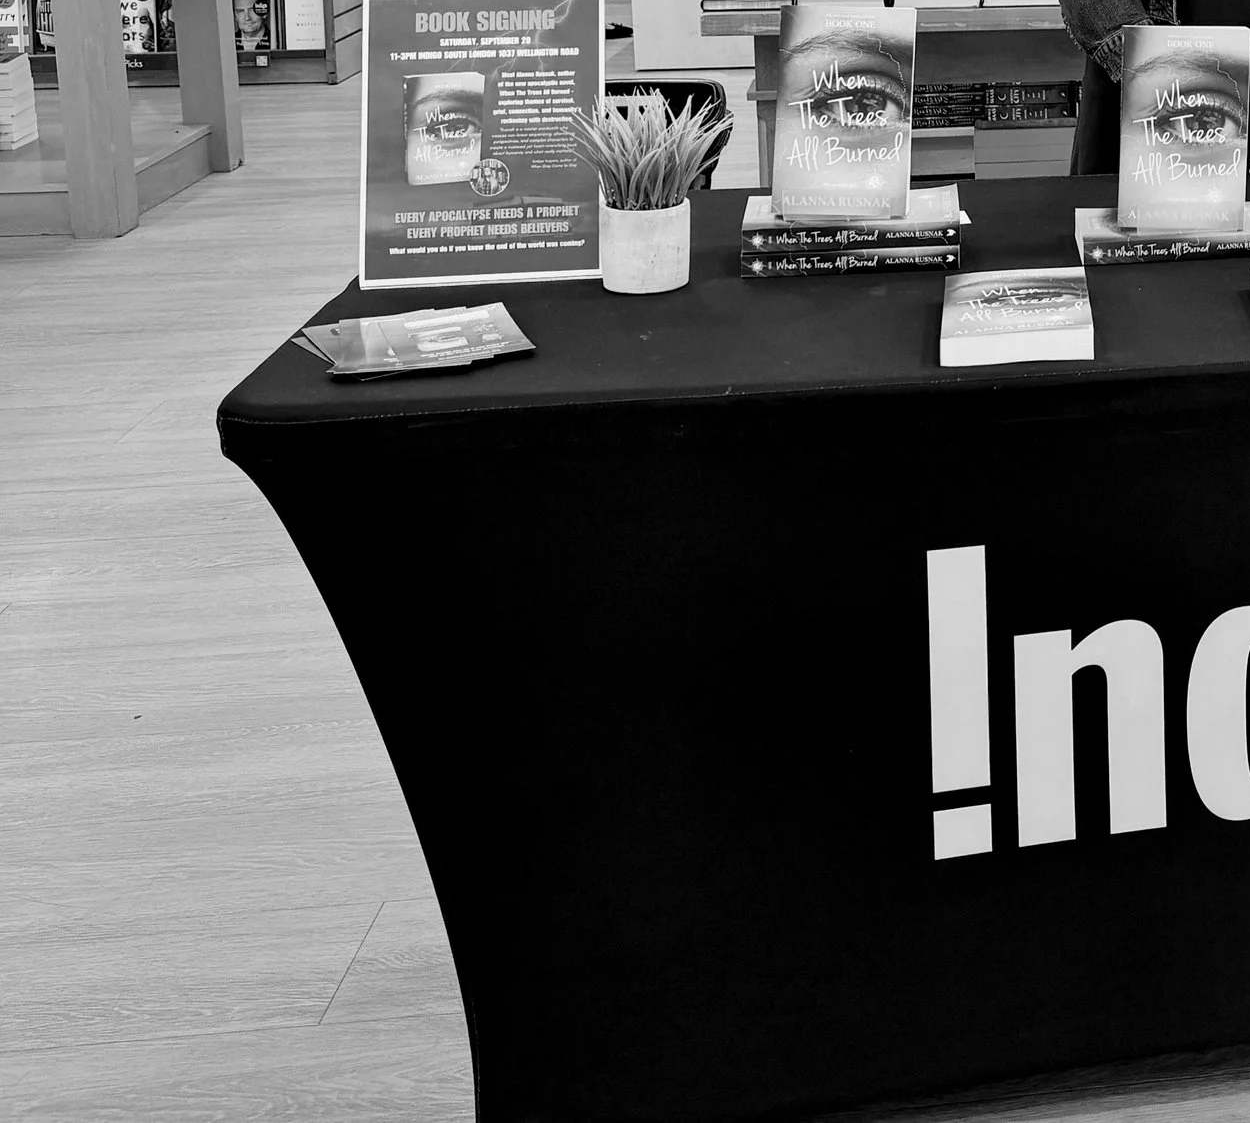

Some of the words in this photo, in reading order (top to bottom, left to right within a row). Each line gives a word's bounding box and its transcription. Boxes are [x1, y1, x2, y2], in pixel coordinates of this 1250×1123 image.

[415, 11, 471, 33] BOOK
[476, 9, 555, 32] SIGNING
[390, 52, 417, 61] 11-3PM
[418, 51, 443, 60] INDIGO
[444, 50, 467, 59] SOUTH
[468, 49, 497, 58] LONDON
[498, 49, 515, 58] 1037
[516, 48, 559, 57] WELLINGTON
[560, 47, 580, 56] ROAD
[440, 38, 479, 47] SATURDAY,
[480, 36, 520, 46] SEPTEMBER
[521, 36, 532, 45] 20
[812, 60, 868, 92] When
[1155, 79, 1208, 110] When
[788, 99, 832, 130] The
[827, 96, 889, 128] Trees
[1133, 116, 1174, 147] The
[1169, 114, 1227, 144] Trees
[786, 137, 819, 171] All
[823, 132, 904, 166] Burned
[1132, 153, 1162, 186] All
[1165, 149, 1241, 181] Burned
[395, 211, 426, 224] EVERY
[428, 209, 491, 222] APOCALYPSE
[493, 207, 524, 220] NEEDS
[526, 207, 534, 218] A
[536, 205, 580, 218] PROPHET
[406, 227, 437, 239] EVERY
[440, 225, 485, 238] PROPHET
[487, 223, 518, 236] NEEDS
[520, 221, 569, 234] BELIEVERS
[775, 233, 797, 244] When
[797, 231, 811, 244] The
[811, 231, 834, 244] Trees
[835, 229, 848, 244] All
[848, 230, 878, 242] Burned
[885, 231, 914, 239] ALANNA
[915, 229, 943, 238] RUSNAK
